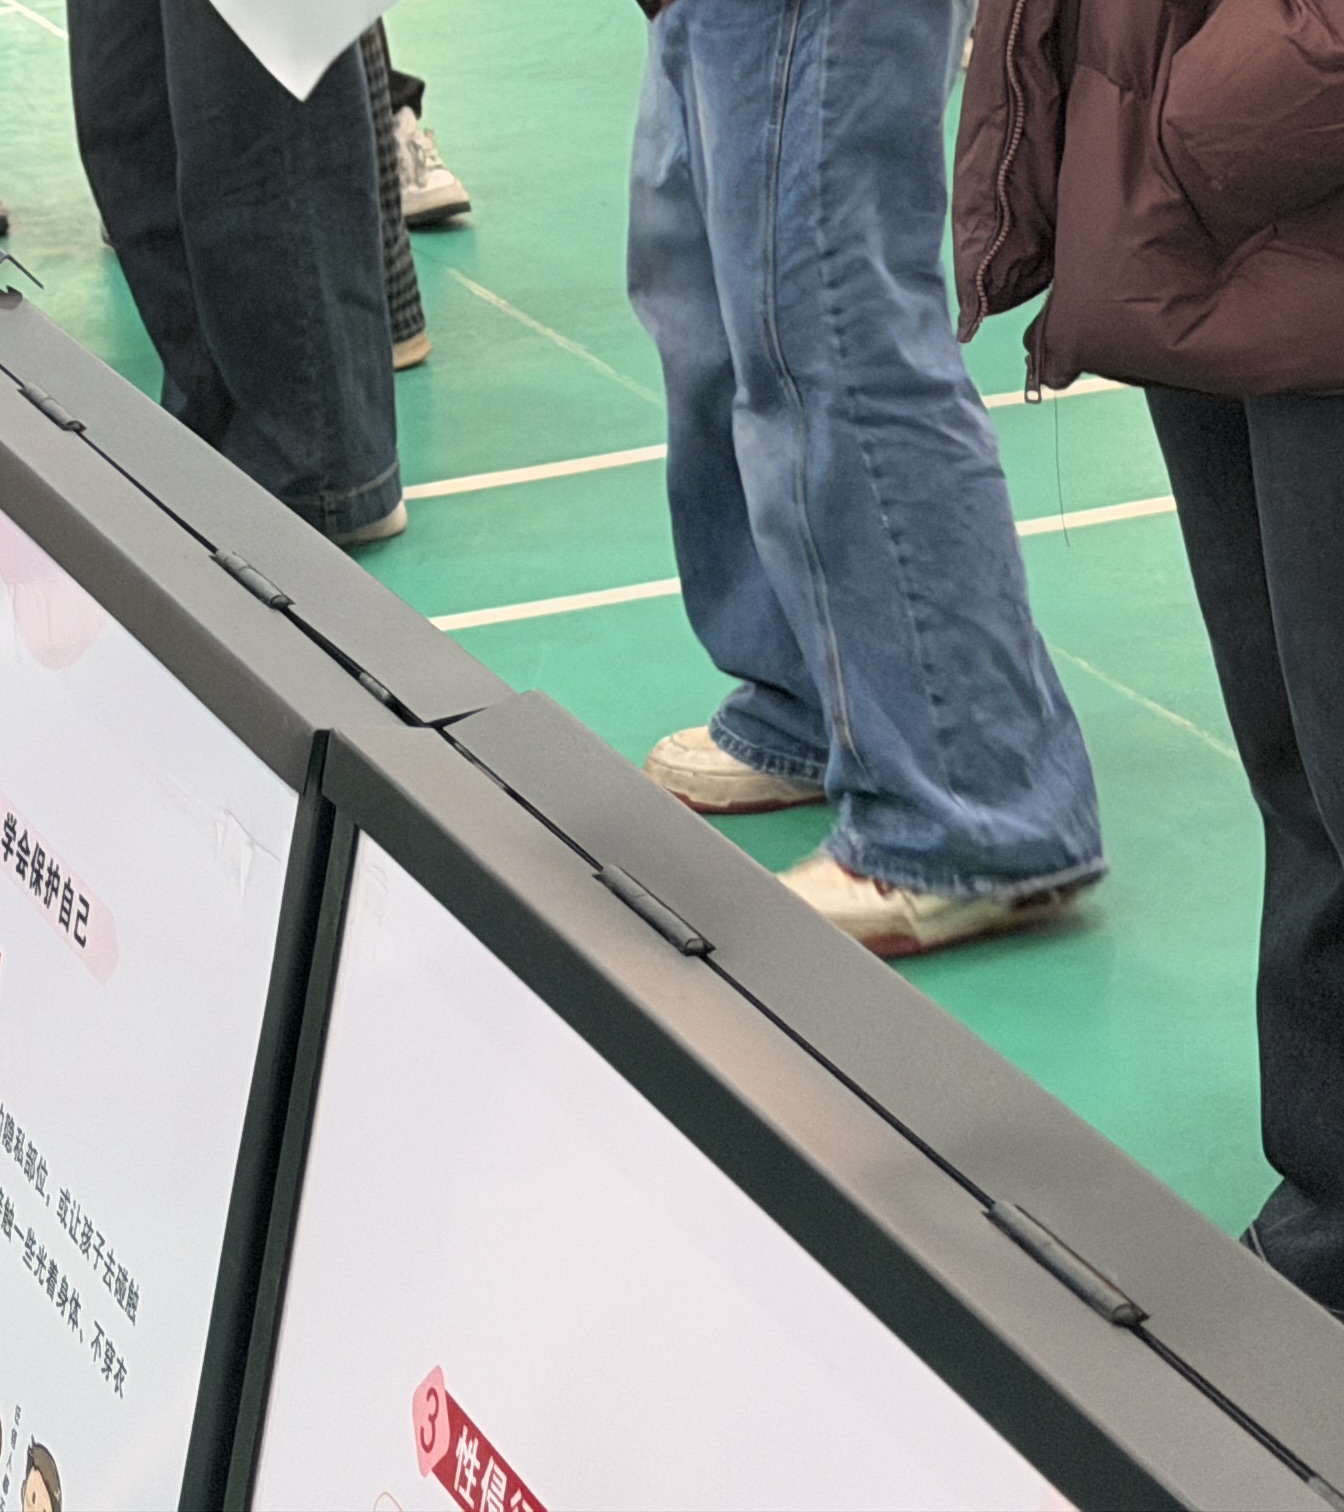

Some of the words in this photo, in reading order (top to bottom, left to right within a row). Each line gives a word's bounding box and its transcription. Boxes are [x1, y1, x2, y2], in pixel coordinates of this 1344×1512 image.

[0, 812, 90, 949] 学会保护自己
[419, 1386, 439, 1454] 3
[454, 1424, 534, 1512] 性侵
